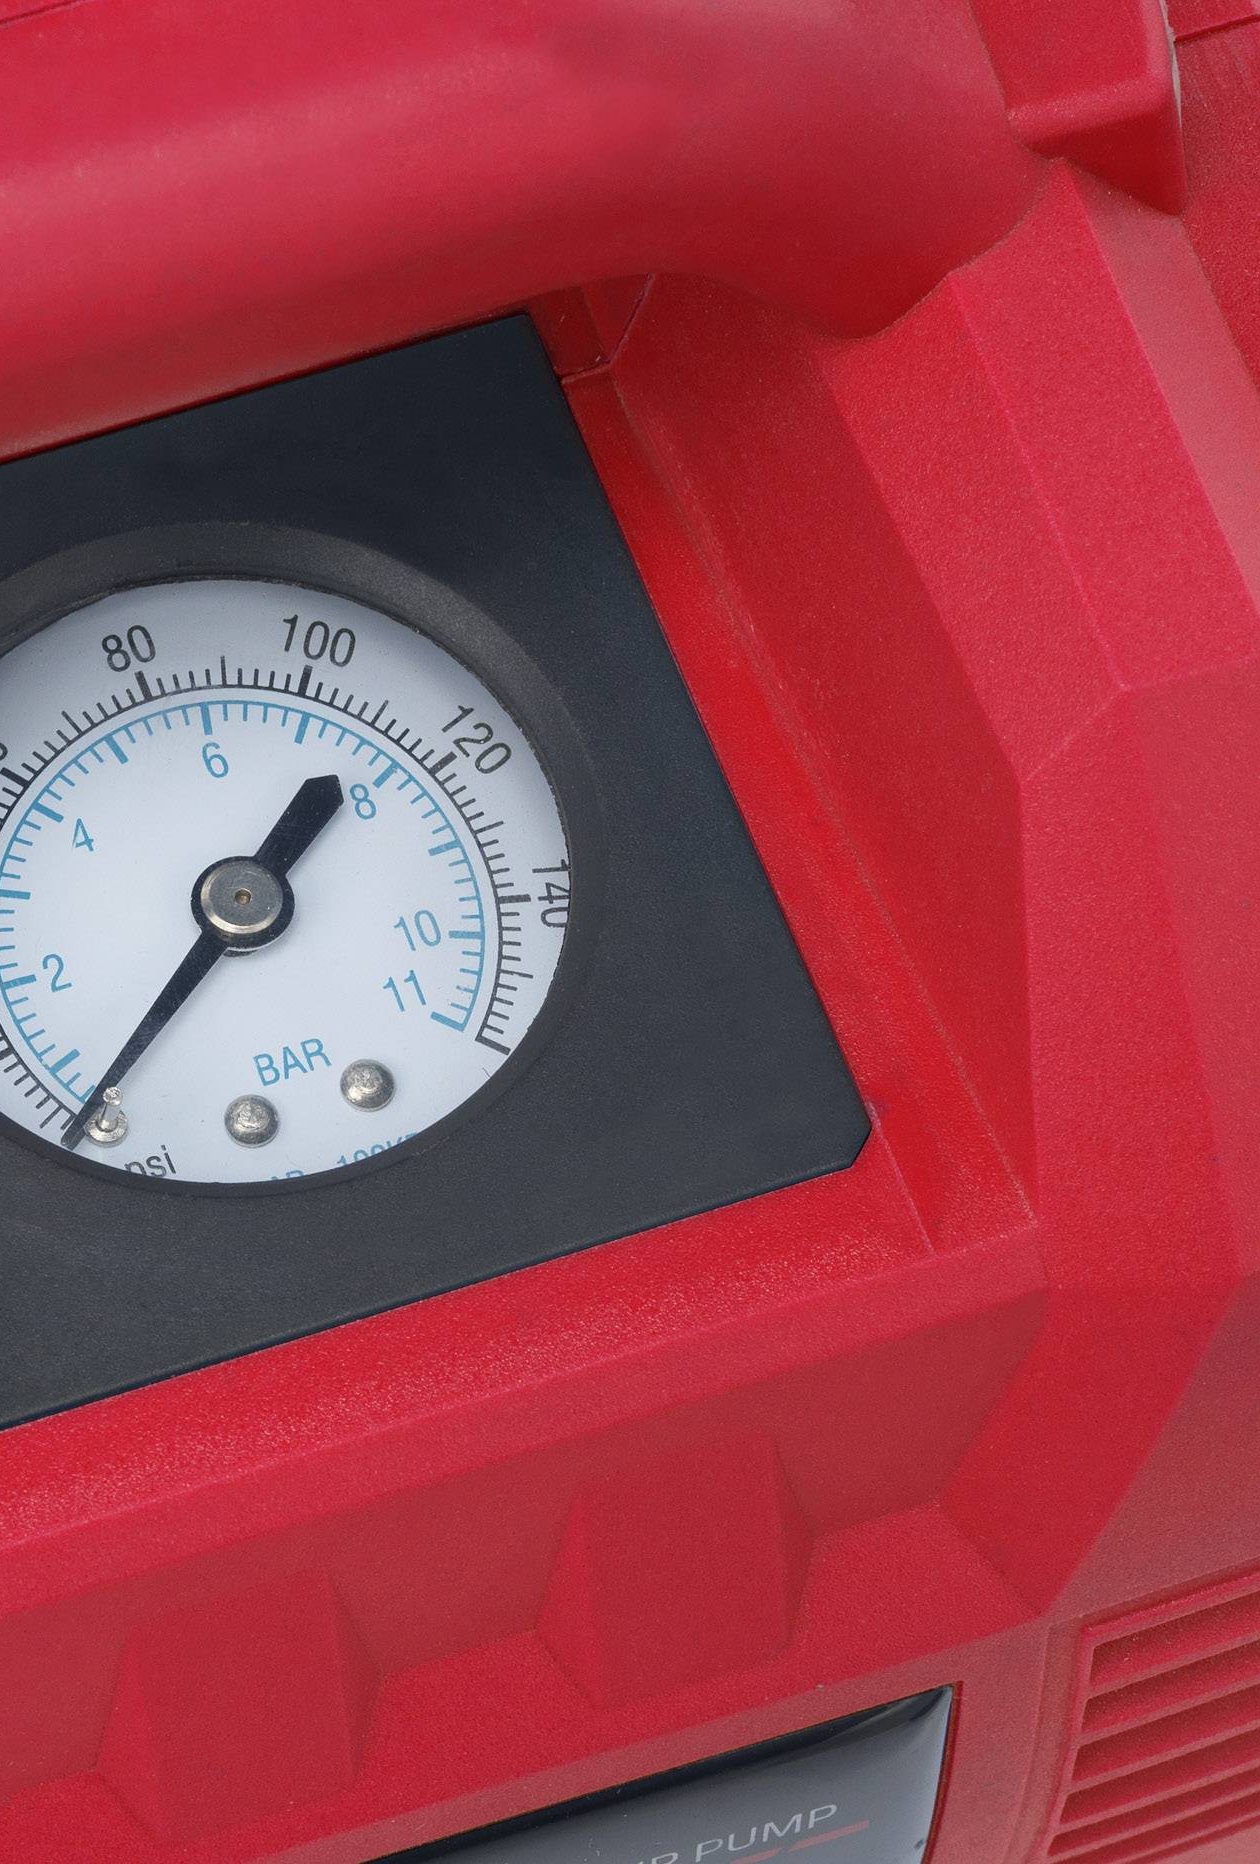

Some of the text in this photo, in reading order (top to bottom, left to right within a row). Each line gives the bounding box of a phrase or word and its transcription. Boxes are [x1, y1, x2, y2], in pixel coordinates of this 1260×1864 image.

[101, 624, 156, 672] 80
[283, 614, 356, 667] 100
[202, 742, 230, 778] 6
[441, 705, 512, 774] 120
[349, 783, 377, 820] 8
[72, 818, 94, 852] 4
[532, 859, 570, 928] 140
[393, 910, 441, 951] 10
[42, 954, 72, 992] 2
[382, 969, 426, 1012] 11
[253, 1038, 332, 1086] BAR
[695, 1804, 838, 1863] PUMP
